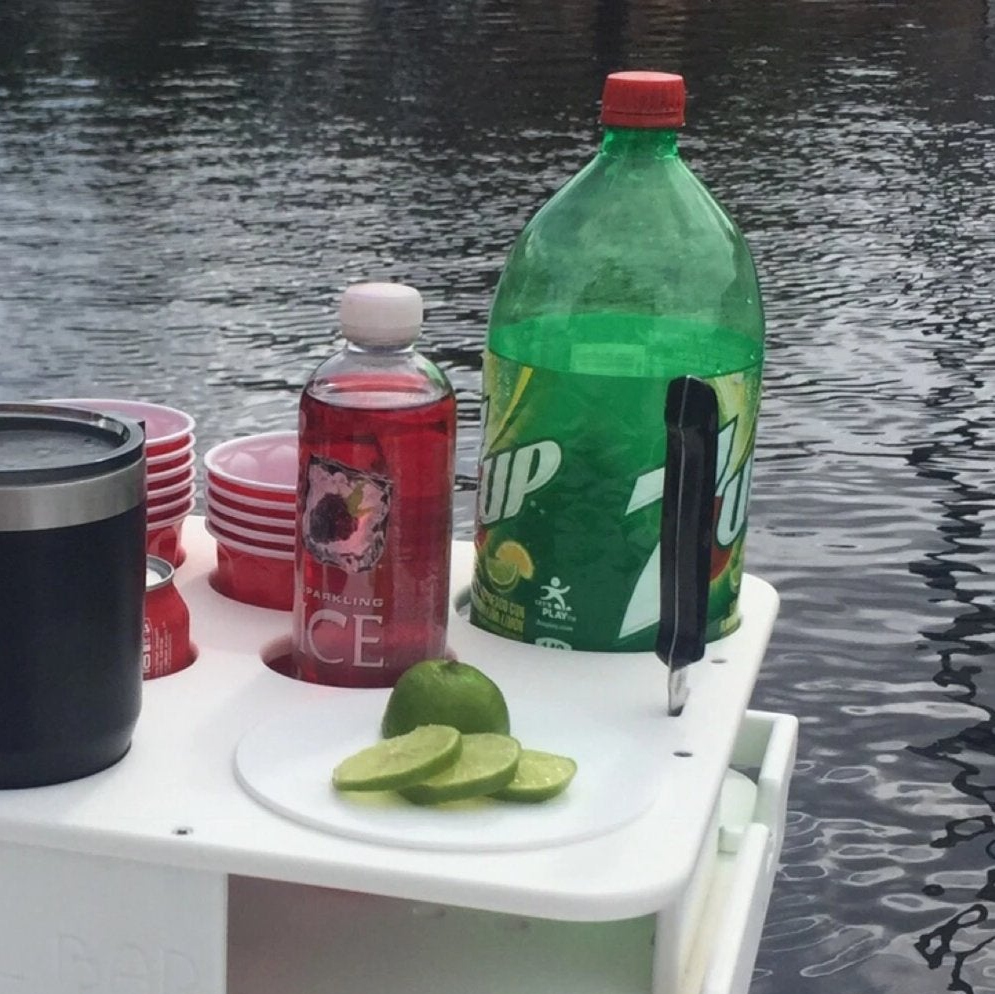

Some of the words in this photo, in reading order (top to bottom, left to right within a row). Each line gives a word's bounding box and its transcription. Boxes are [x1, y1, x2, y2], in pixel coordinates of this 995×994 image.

[479, 400, 562, 525] UP
[305, 586, 384, 607] PARKLING
[542, 606, 568, 620] PLAY
